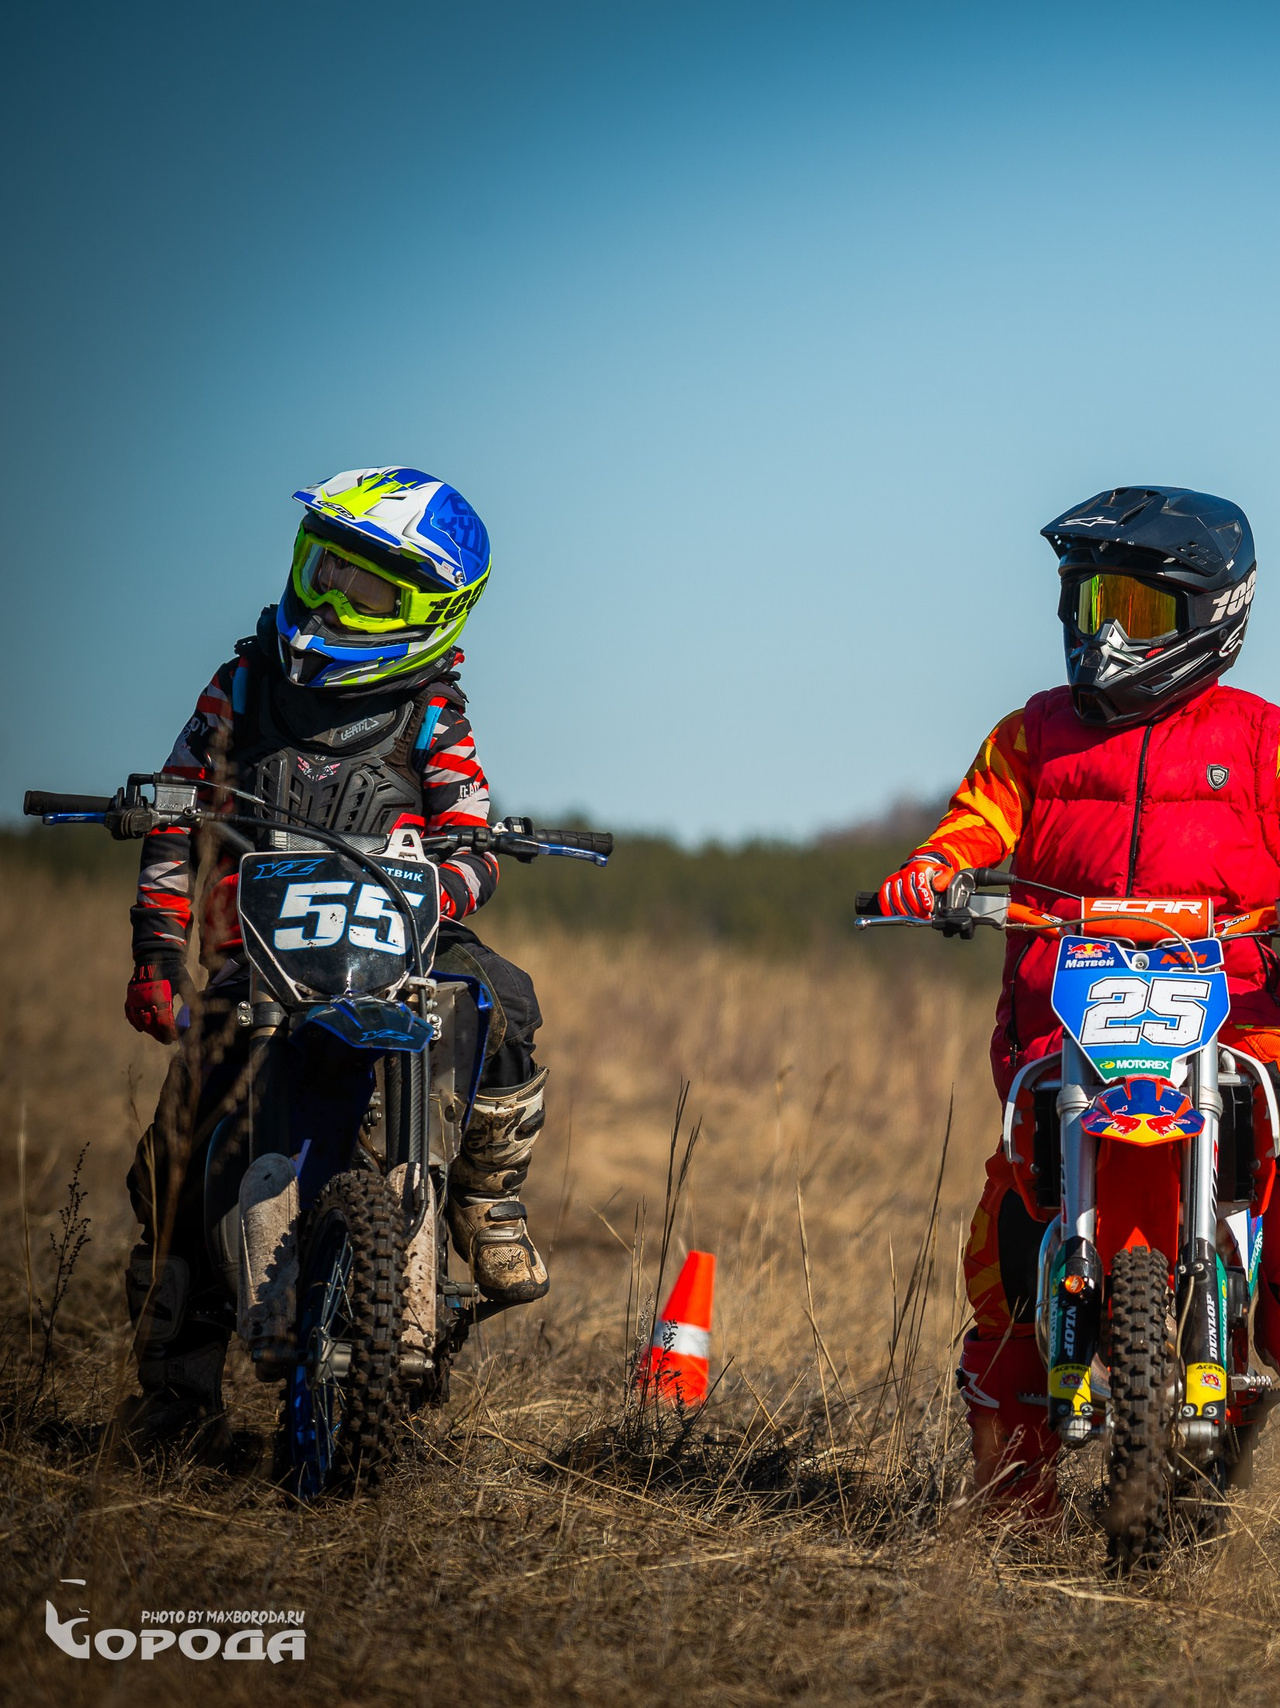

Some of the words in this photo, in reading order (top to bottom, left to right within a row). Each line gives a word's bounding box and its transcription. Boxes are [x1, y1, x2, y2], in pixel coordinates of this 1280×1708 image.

[273, 881, 426, 956] 55
[1090, 900, 1203, 915] SCAR
[1065, 957, 1115, 969] Матвей
[1079, 976, 1211, 1047] 25
[1116, 1059, 1169, 1071] MOTOREX
[1064, 1305, 1077, 1357] NLOP
[1206, 1293, 1218, 1361] DUNLOP
